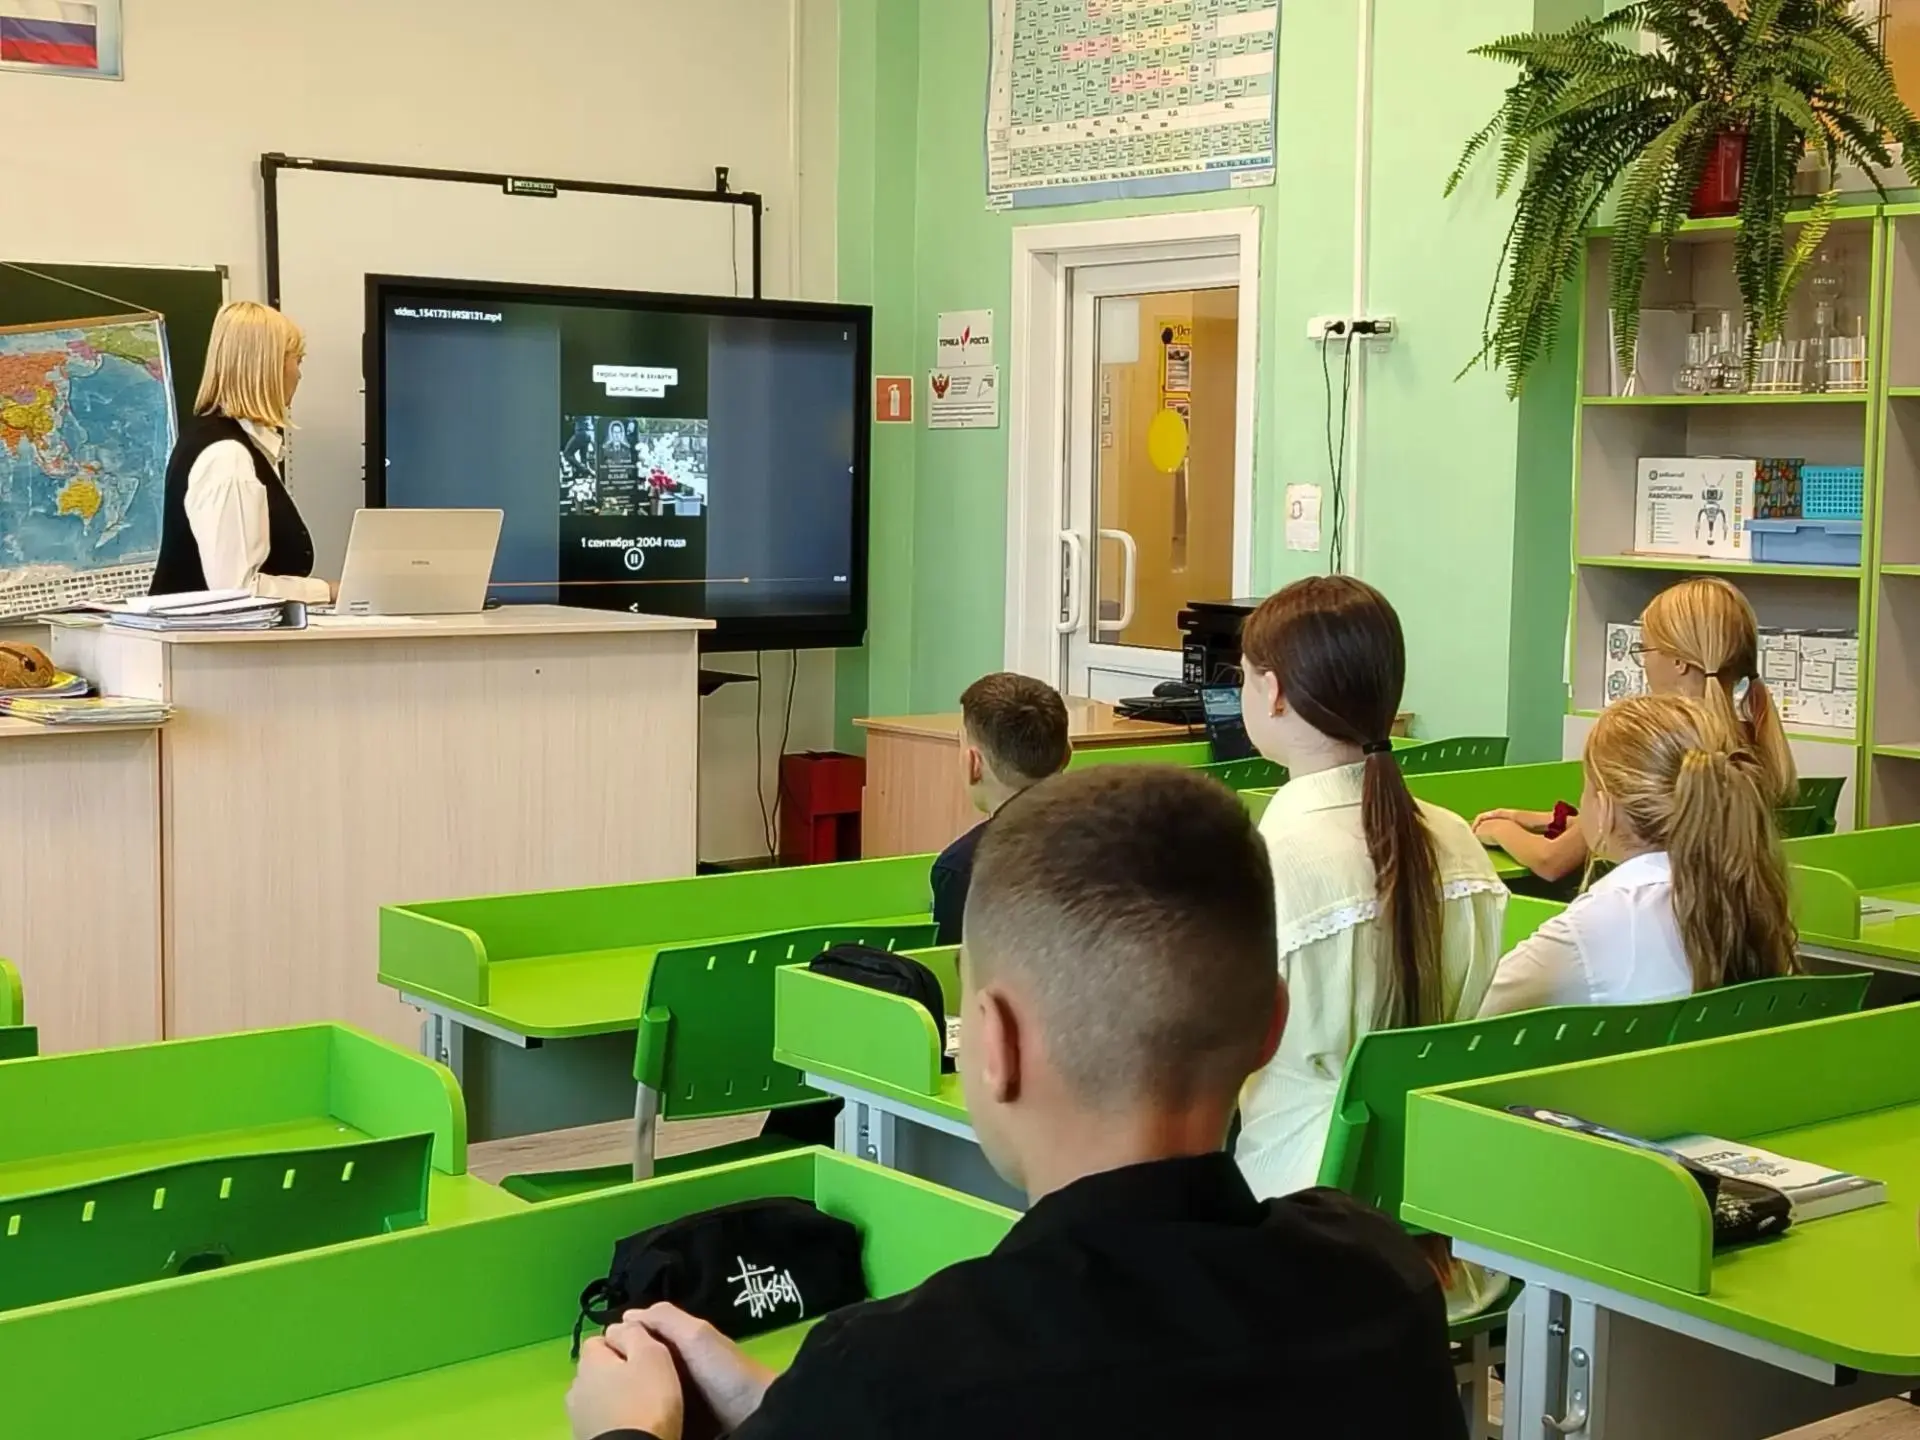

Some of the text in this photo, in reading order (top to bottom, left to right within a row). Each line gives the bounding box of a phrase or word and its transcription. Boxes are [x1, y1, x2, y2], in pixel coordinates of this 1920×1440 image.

[970, 336, 989, 345] РОСТА
[588, 537, 635, 549] сентября
[636, 537, 661, 548] 2004
[664, 539, 687, 548] года
